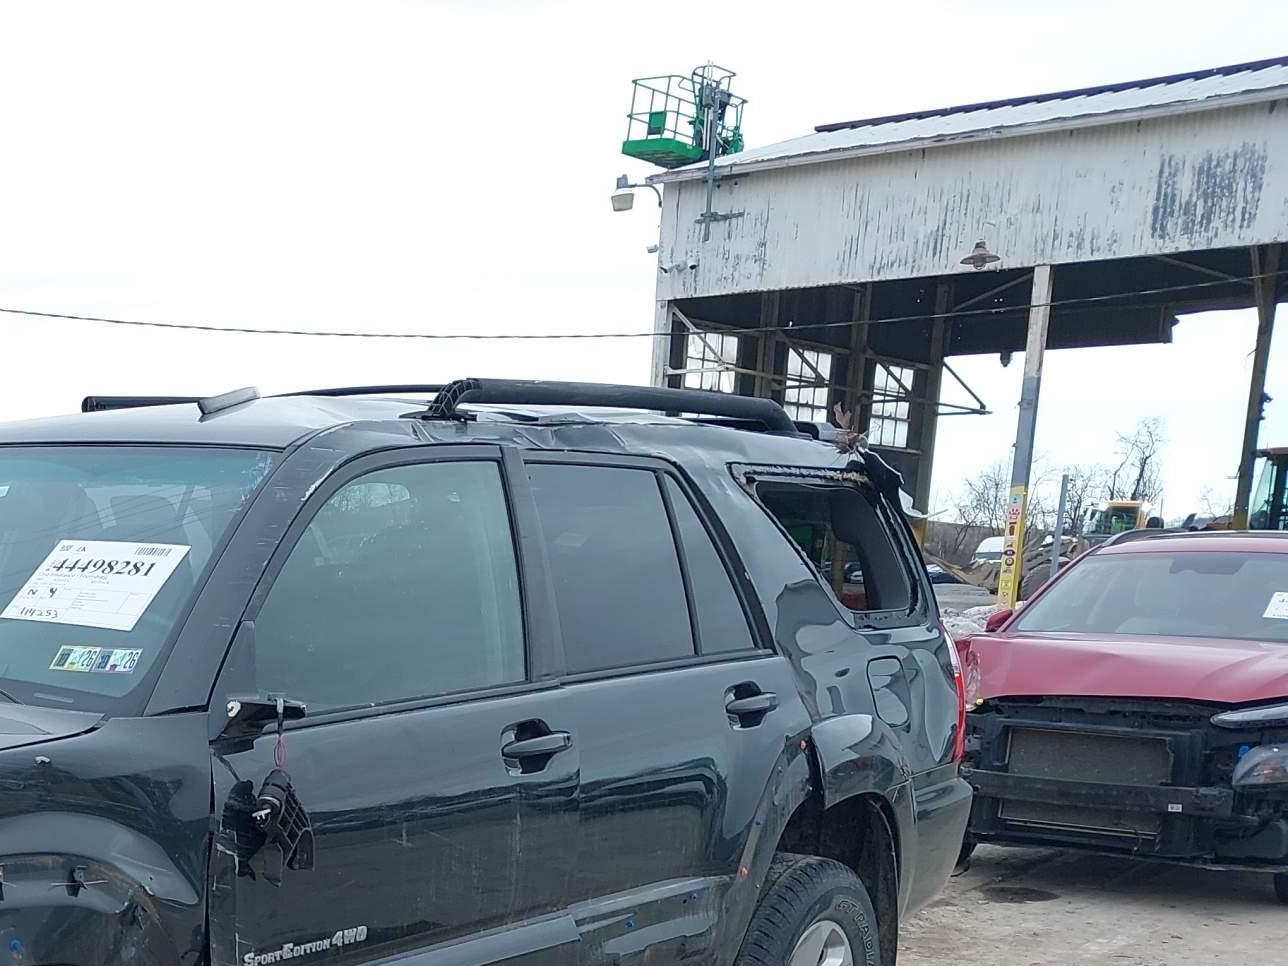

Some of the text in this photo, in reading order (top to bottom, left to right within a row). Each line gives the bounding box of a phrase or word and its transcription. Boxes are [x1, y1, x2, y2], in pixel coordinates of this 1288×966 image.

[53, 558, 156, 577] 44498281
[80, 650, 98, 667] 26
[122, 651, 139, 669] 26
[331, 925, 368, 947] 4WD
